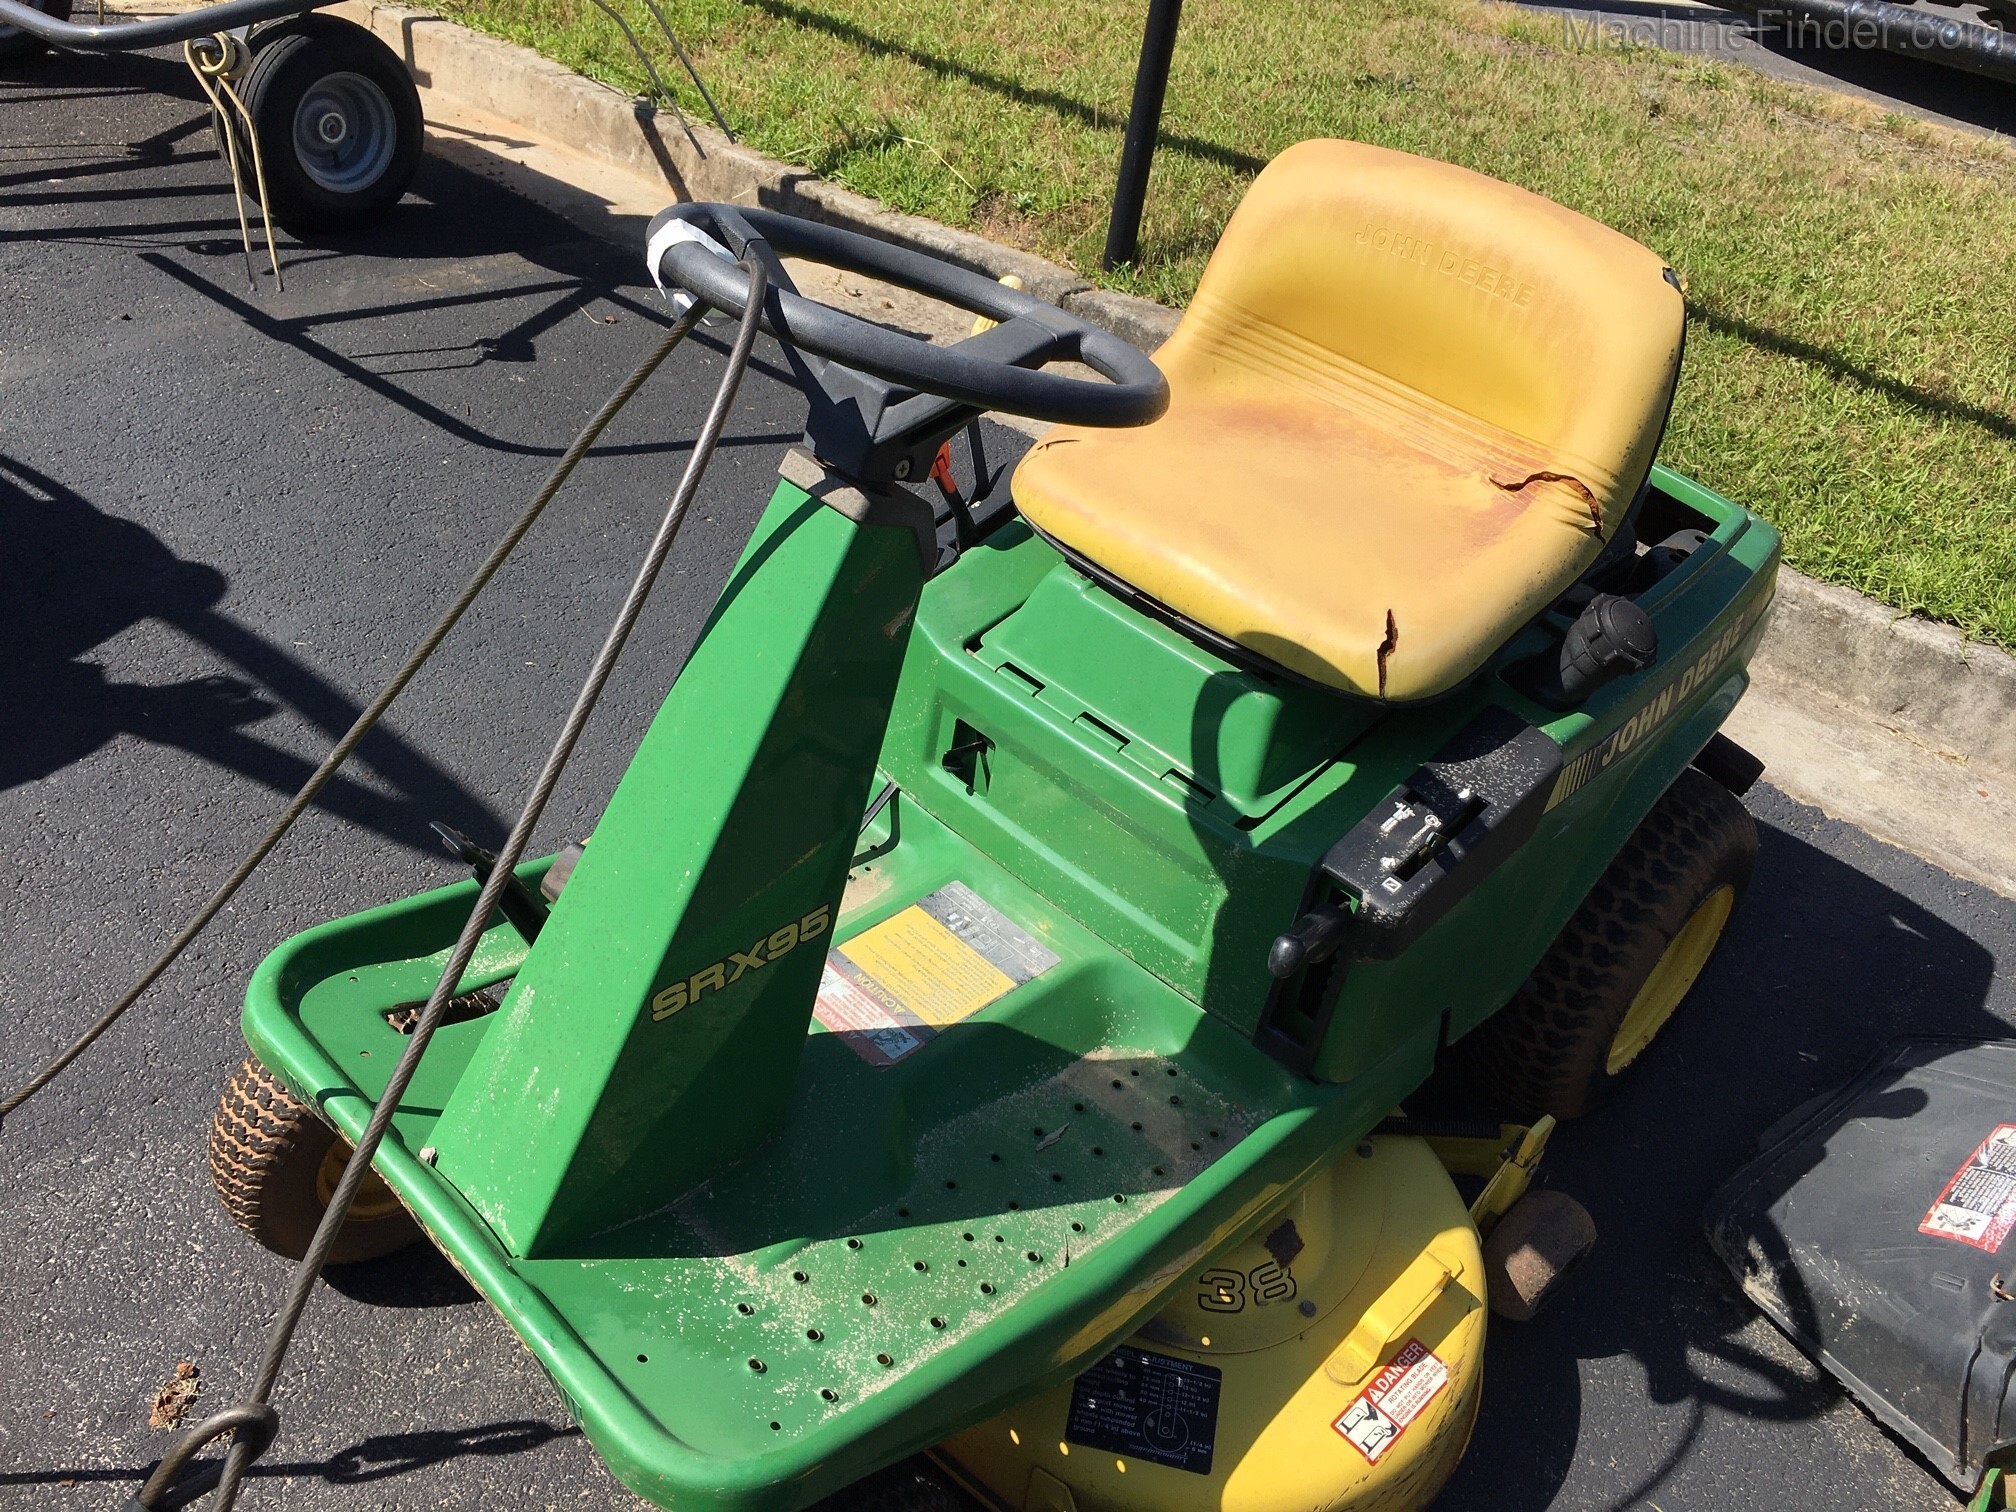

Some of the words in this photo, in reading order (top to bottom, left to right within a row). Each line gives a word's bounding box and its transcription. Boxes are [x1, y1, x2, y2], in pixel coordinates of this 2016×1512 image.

[1355, 223, 1432, 266] JOHN
[1438, 250, 1537, 310] DEERE
[1602, 683, 1674, 767] JOHN
[1678, 612, 1744, 703] DEERE
[651, 903, 830, 1024] SRX95
[853, 972, 897, 1008] CAUTION
[1198, 1260, 1297, 1314] 38
[1374, 1342, 1424, 1393] DANGER
[1388, 1377, 1412, 1404] ROTATING
[1410, 1361, 1427, 1379] BLADE
[1419, 1375, 1433, 1391] MOWER
[1395, 1399, 1404, 1408] NOT
[1120, 1427, 1141, 1437] above
